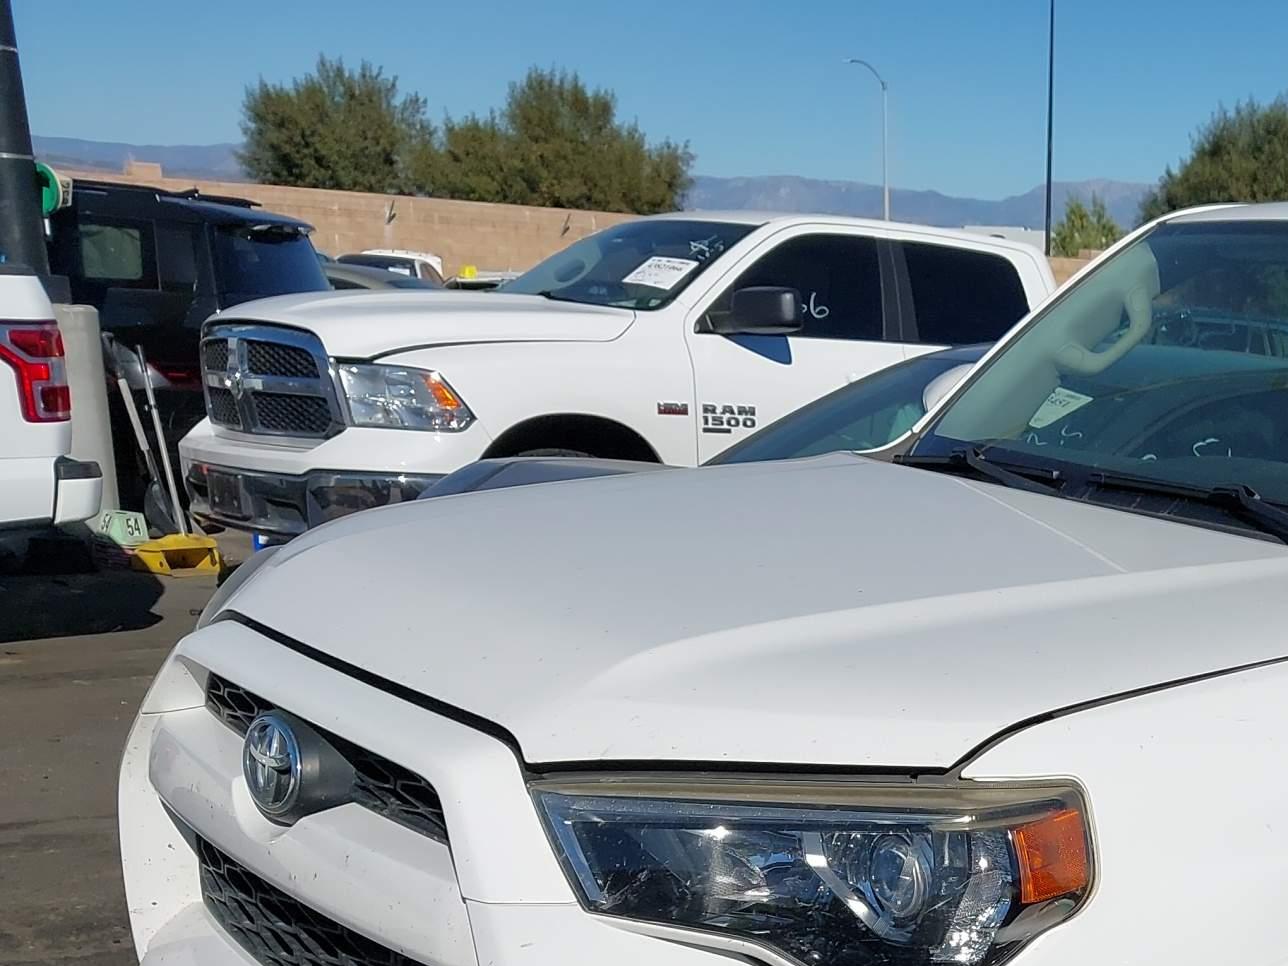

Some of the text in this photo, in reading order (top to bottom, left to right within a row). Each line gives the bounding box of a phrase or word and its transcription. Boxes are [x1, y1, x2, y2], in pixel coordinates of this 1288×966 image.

[702, 404, 756, 416] RAM
[703, 416, 756, 428] 1500
[126, 518, 141, 536] 54
